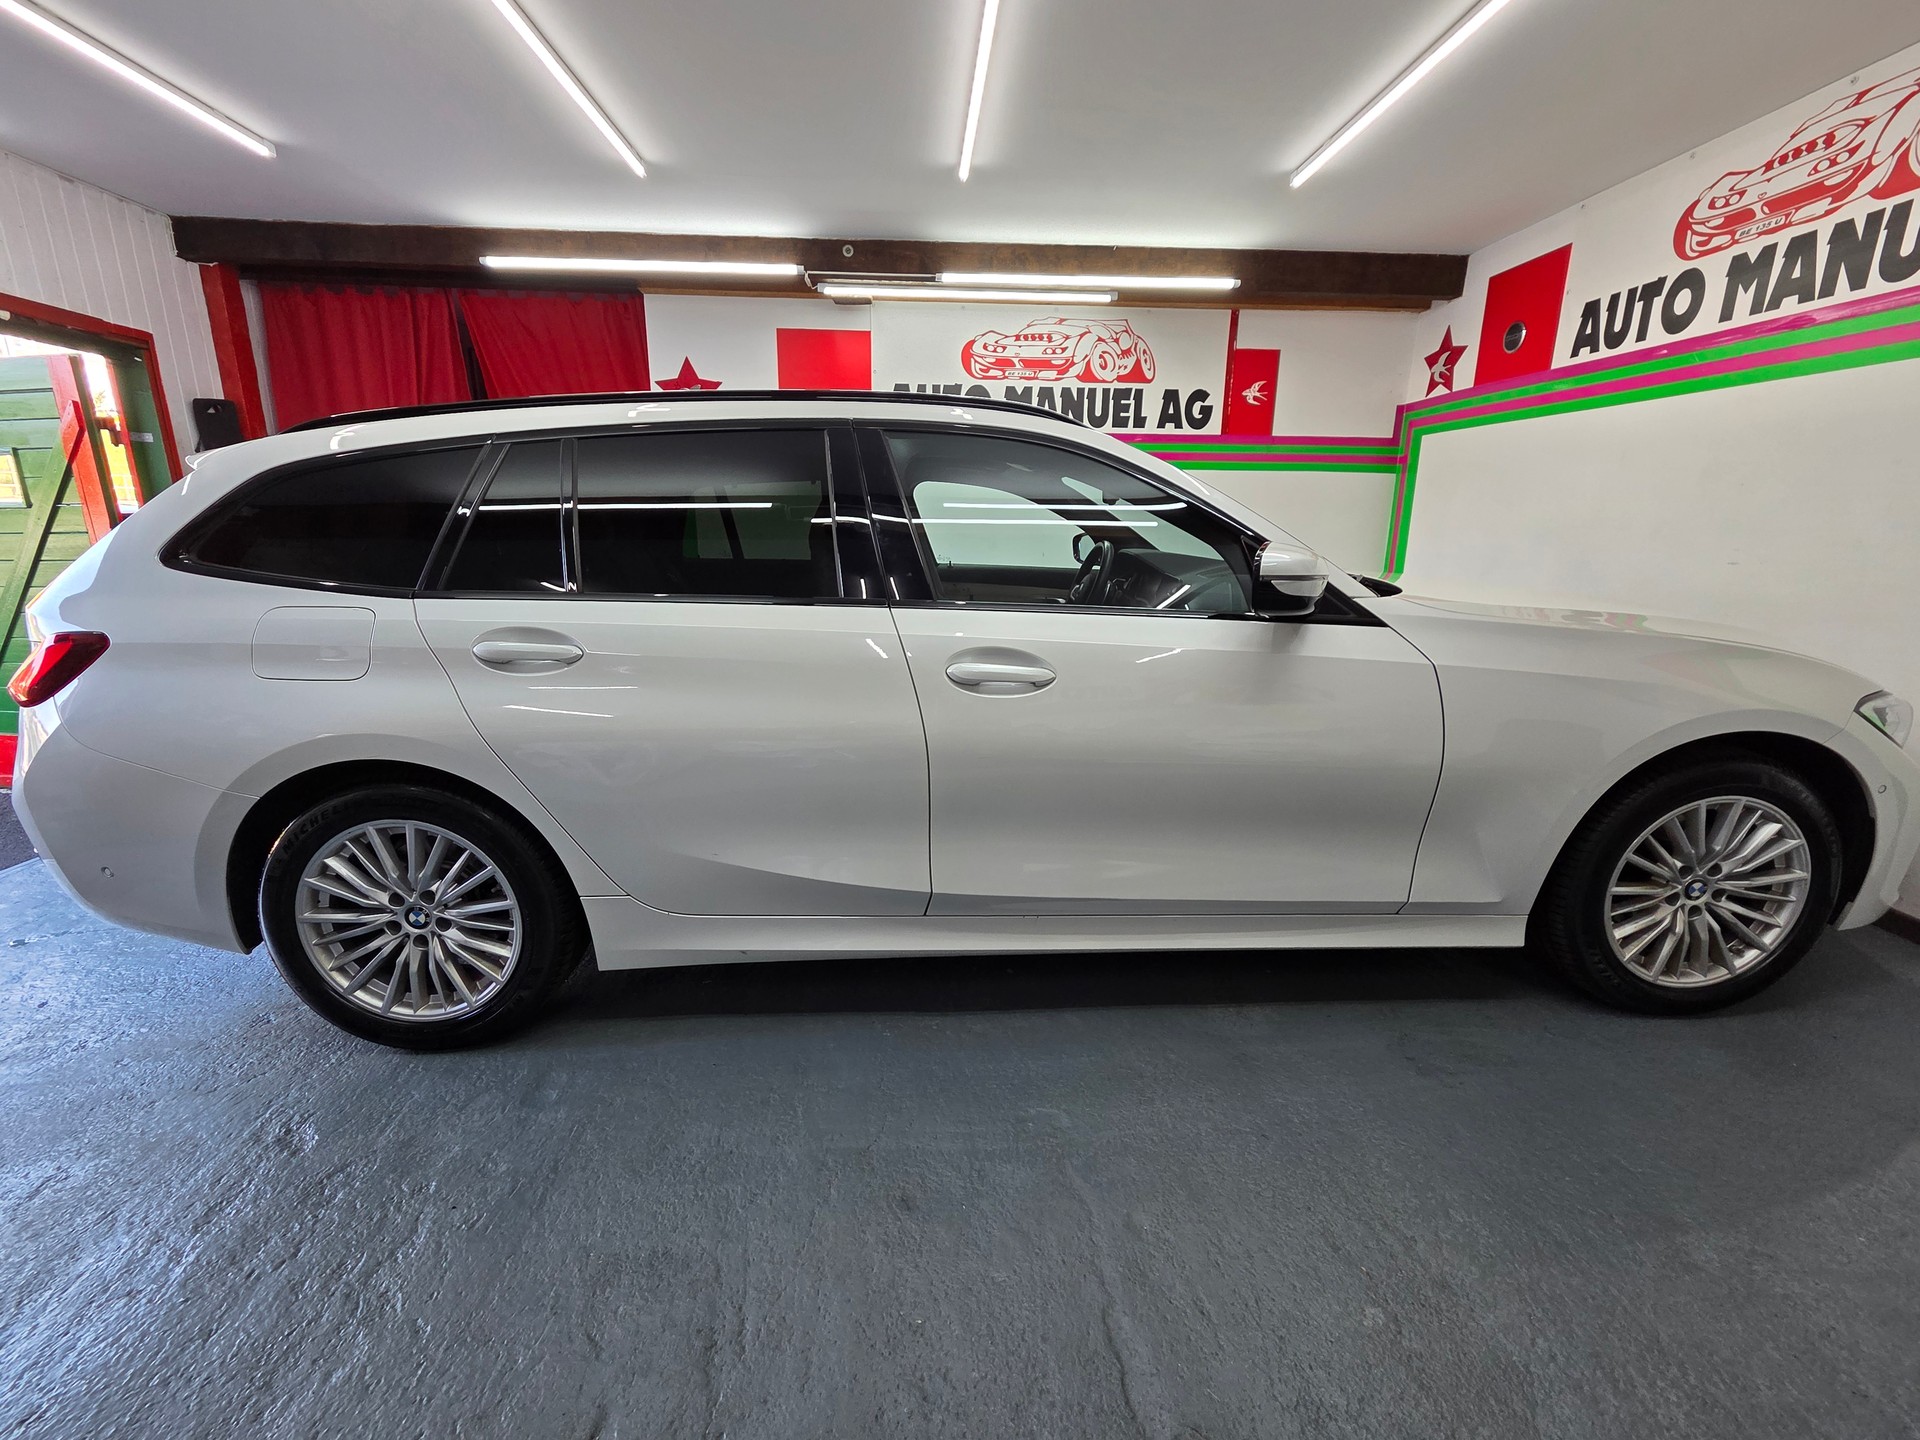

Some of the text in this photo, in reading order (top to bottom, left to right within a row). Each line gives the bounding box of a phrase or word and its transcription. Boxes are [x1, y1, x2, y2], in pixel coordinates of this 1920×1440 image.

[1738, 227, 1753, 238] BE
[1570, 267, 1706, 359] AUTO
[1156, 388, 1214, 430] AG
